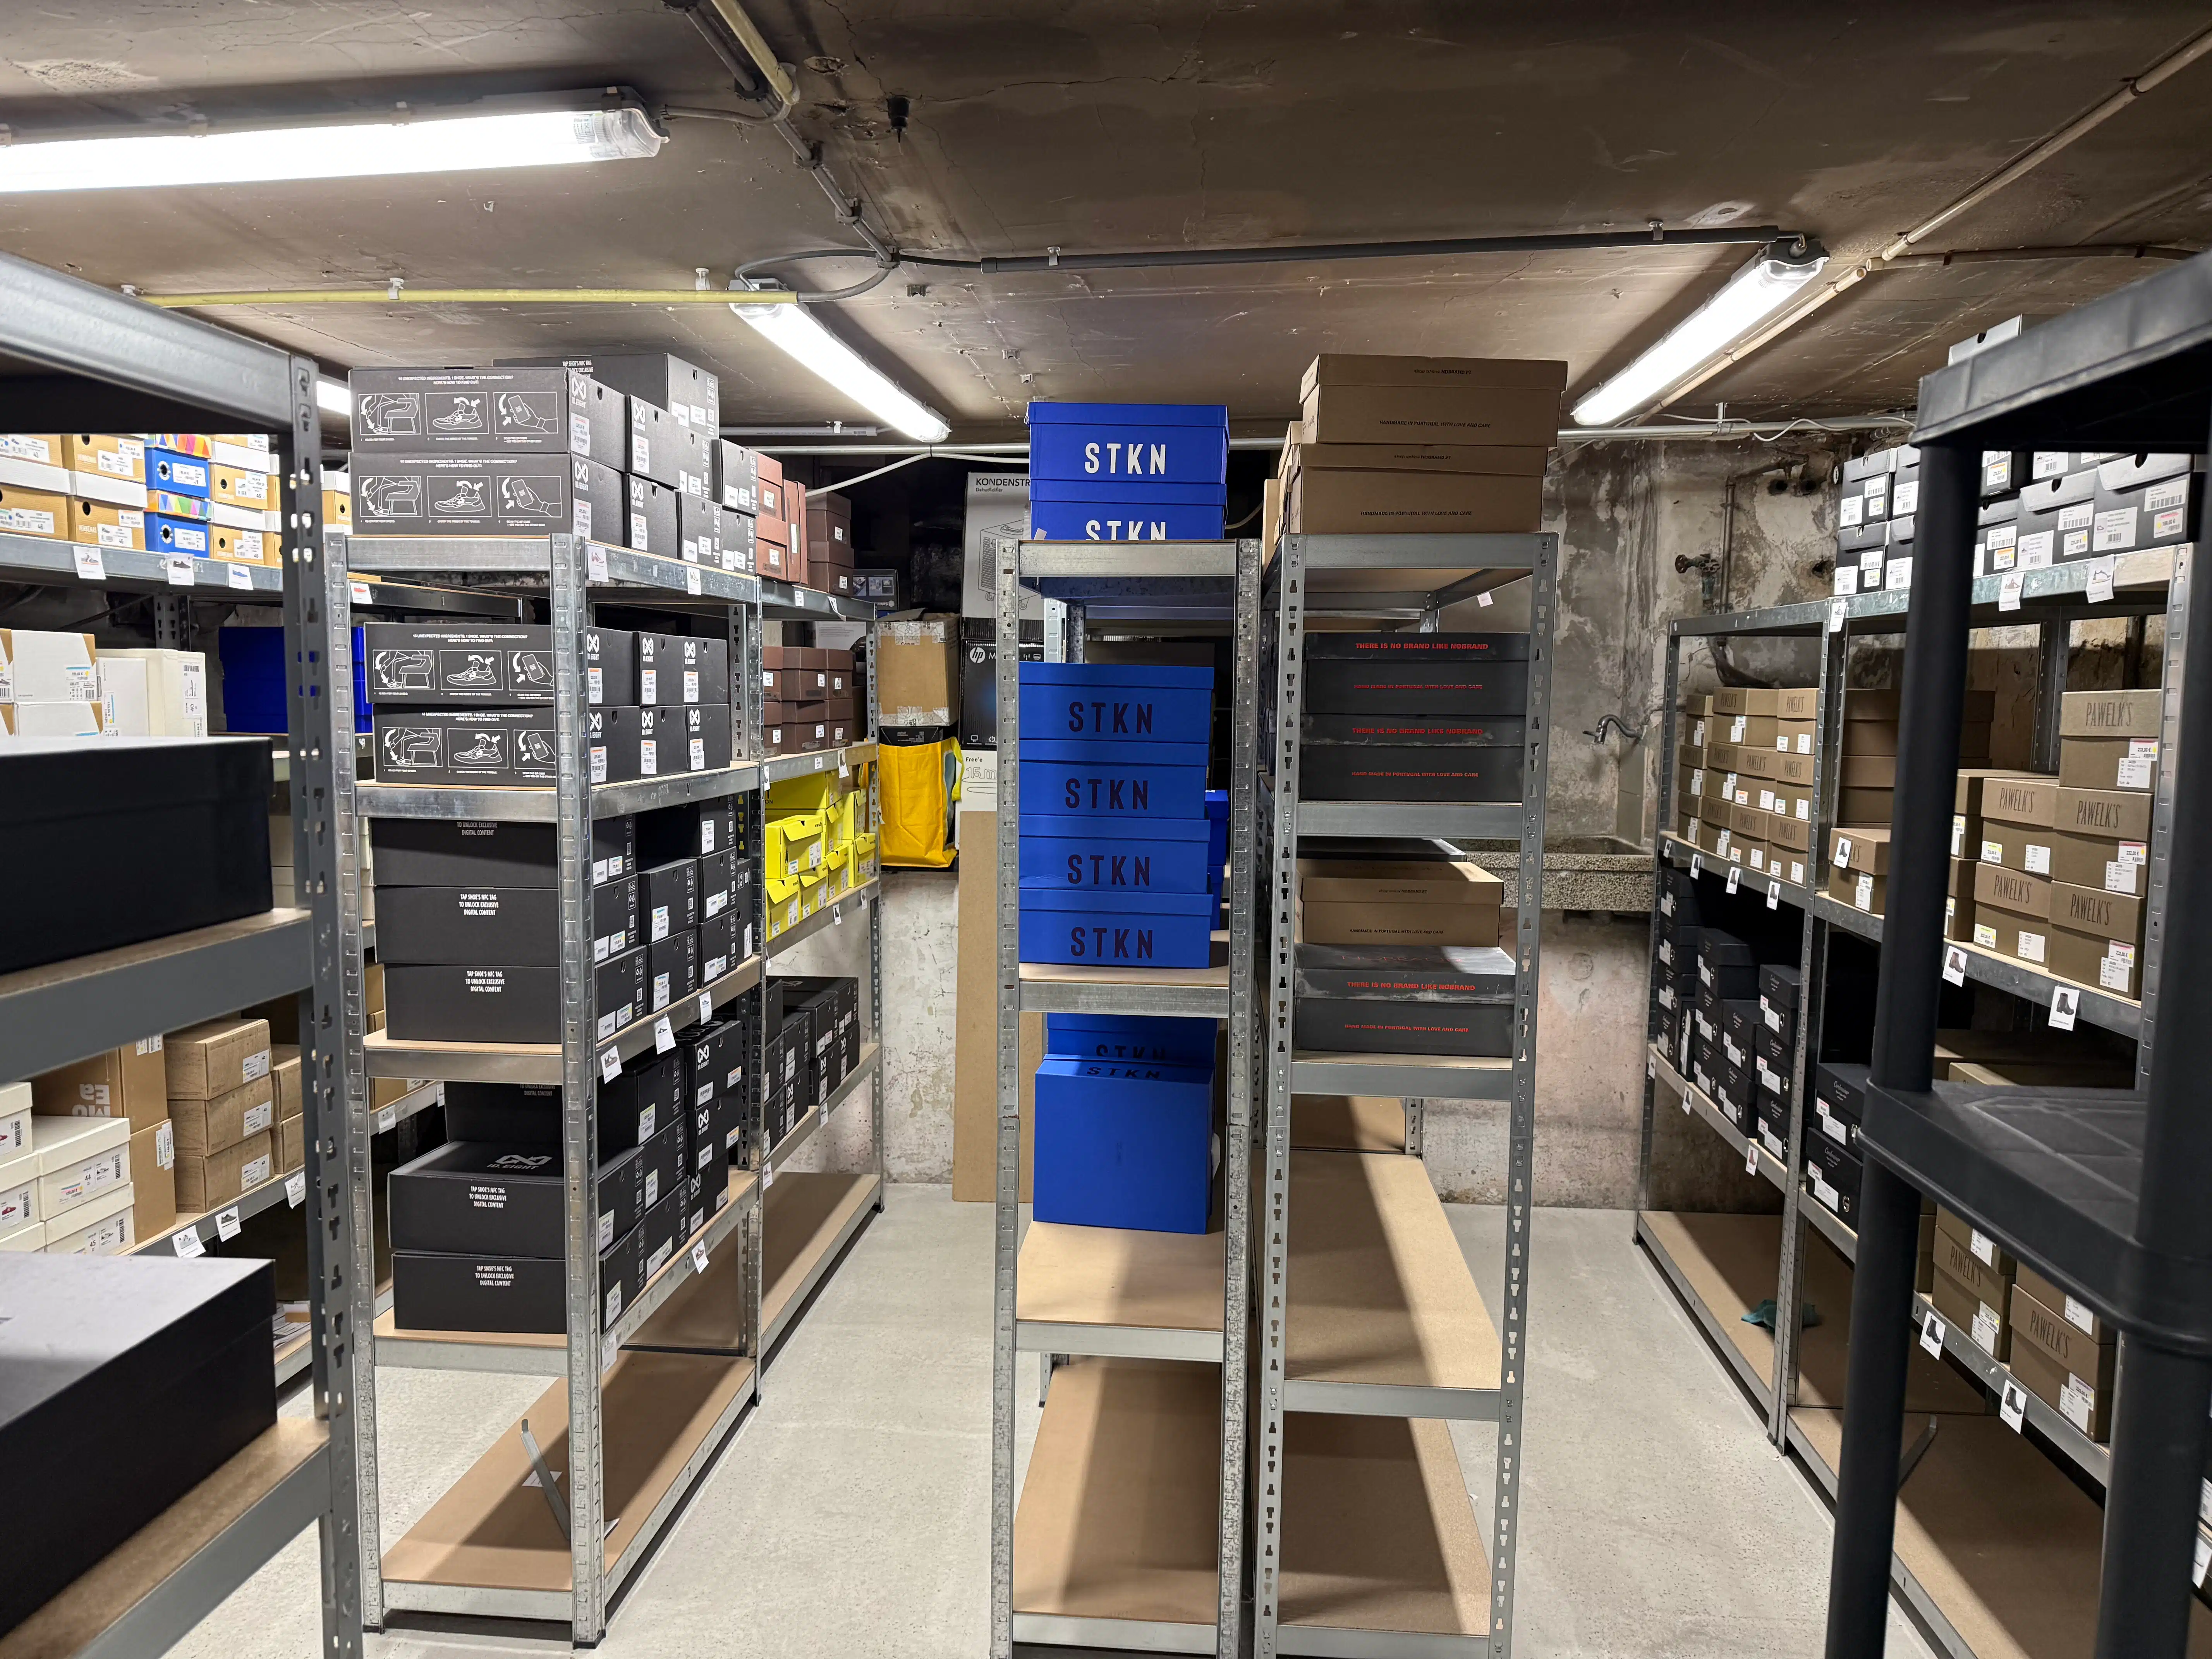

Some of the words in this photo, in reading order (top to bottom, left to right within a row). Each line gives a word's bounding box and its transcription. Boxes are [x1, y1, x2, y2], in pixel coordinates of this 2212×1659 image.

[1085, 443, 1166, 475] STKN
[1086, 520, 1166, 540] STKN
[972, 647, 984, 663] hp
[1069, 702, 1152, 734] STKN
[1786, 696, 1804, 713] PAWELK'S
[2086, 702, 2133, 726] PAWELK'S
[1747, 755, 1767, 772] PAWELK'S
[1066, 778, 1148, 809] STKN
[1999, 788, 2035, 812] PAWELK'S
[2076, 800, 2122, 828] PAWELK'S
[1779, 822, 1796, 840] PAWELK'S
[1068, 855, 1150, 886] STKN
[1994, 875, 2032, 903] PAWELK'S
[2071, 894, 2112, 925] PAWELK'S
[1071, 927, 1153, 959] STKN
[1087, 1067, 1159, 1079] STKN
[79, 1084, 110, 1104] Ea
[1950, 1246, 1982, 1288] PAWELK'S
[2030, 1310, 2070, 1358] PAWELK'S
